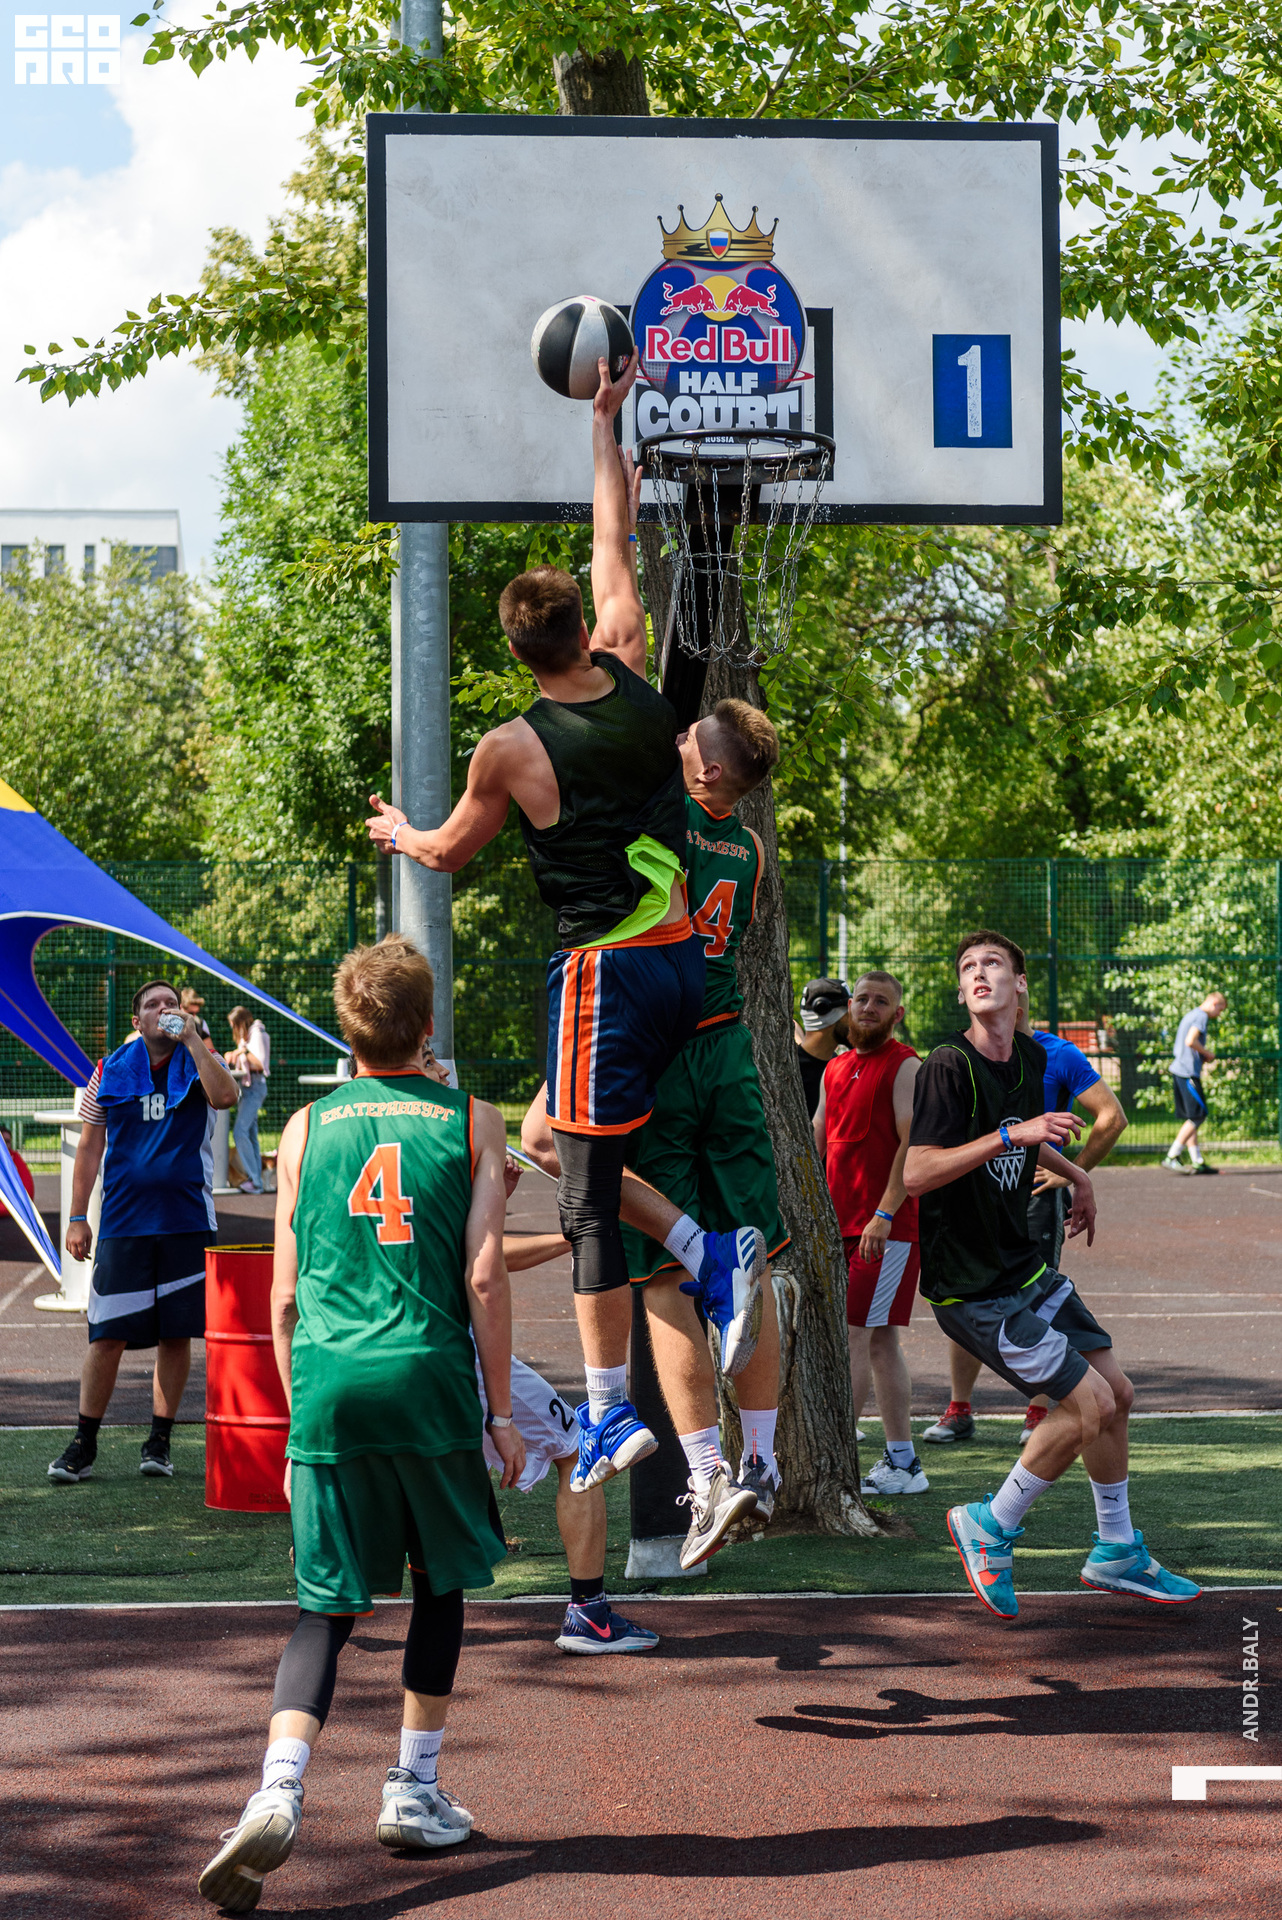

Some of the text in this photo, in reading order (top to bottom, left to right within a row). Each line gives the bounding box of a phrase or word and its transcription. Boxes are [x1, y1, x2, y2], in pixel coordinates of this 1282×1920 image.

[646, 325, 791, 364] Red Bull
[679, 371, 758, 395] HALF
[958, 345, 982, 437] 1
[637, 390, 799, 439] COURT
[705, 436, 735, 444] RUSSIA
[690, 878, 738, 958] 4
[139, 1093, 165, 1121] 18
[320, 1100, 455, 1126] ЕКАТЕРИНБУРГ
[347, 1142, 415, 1246] 4
